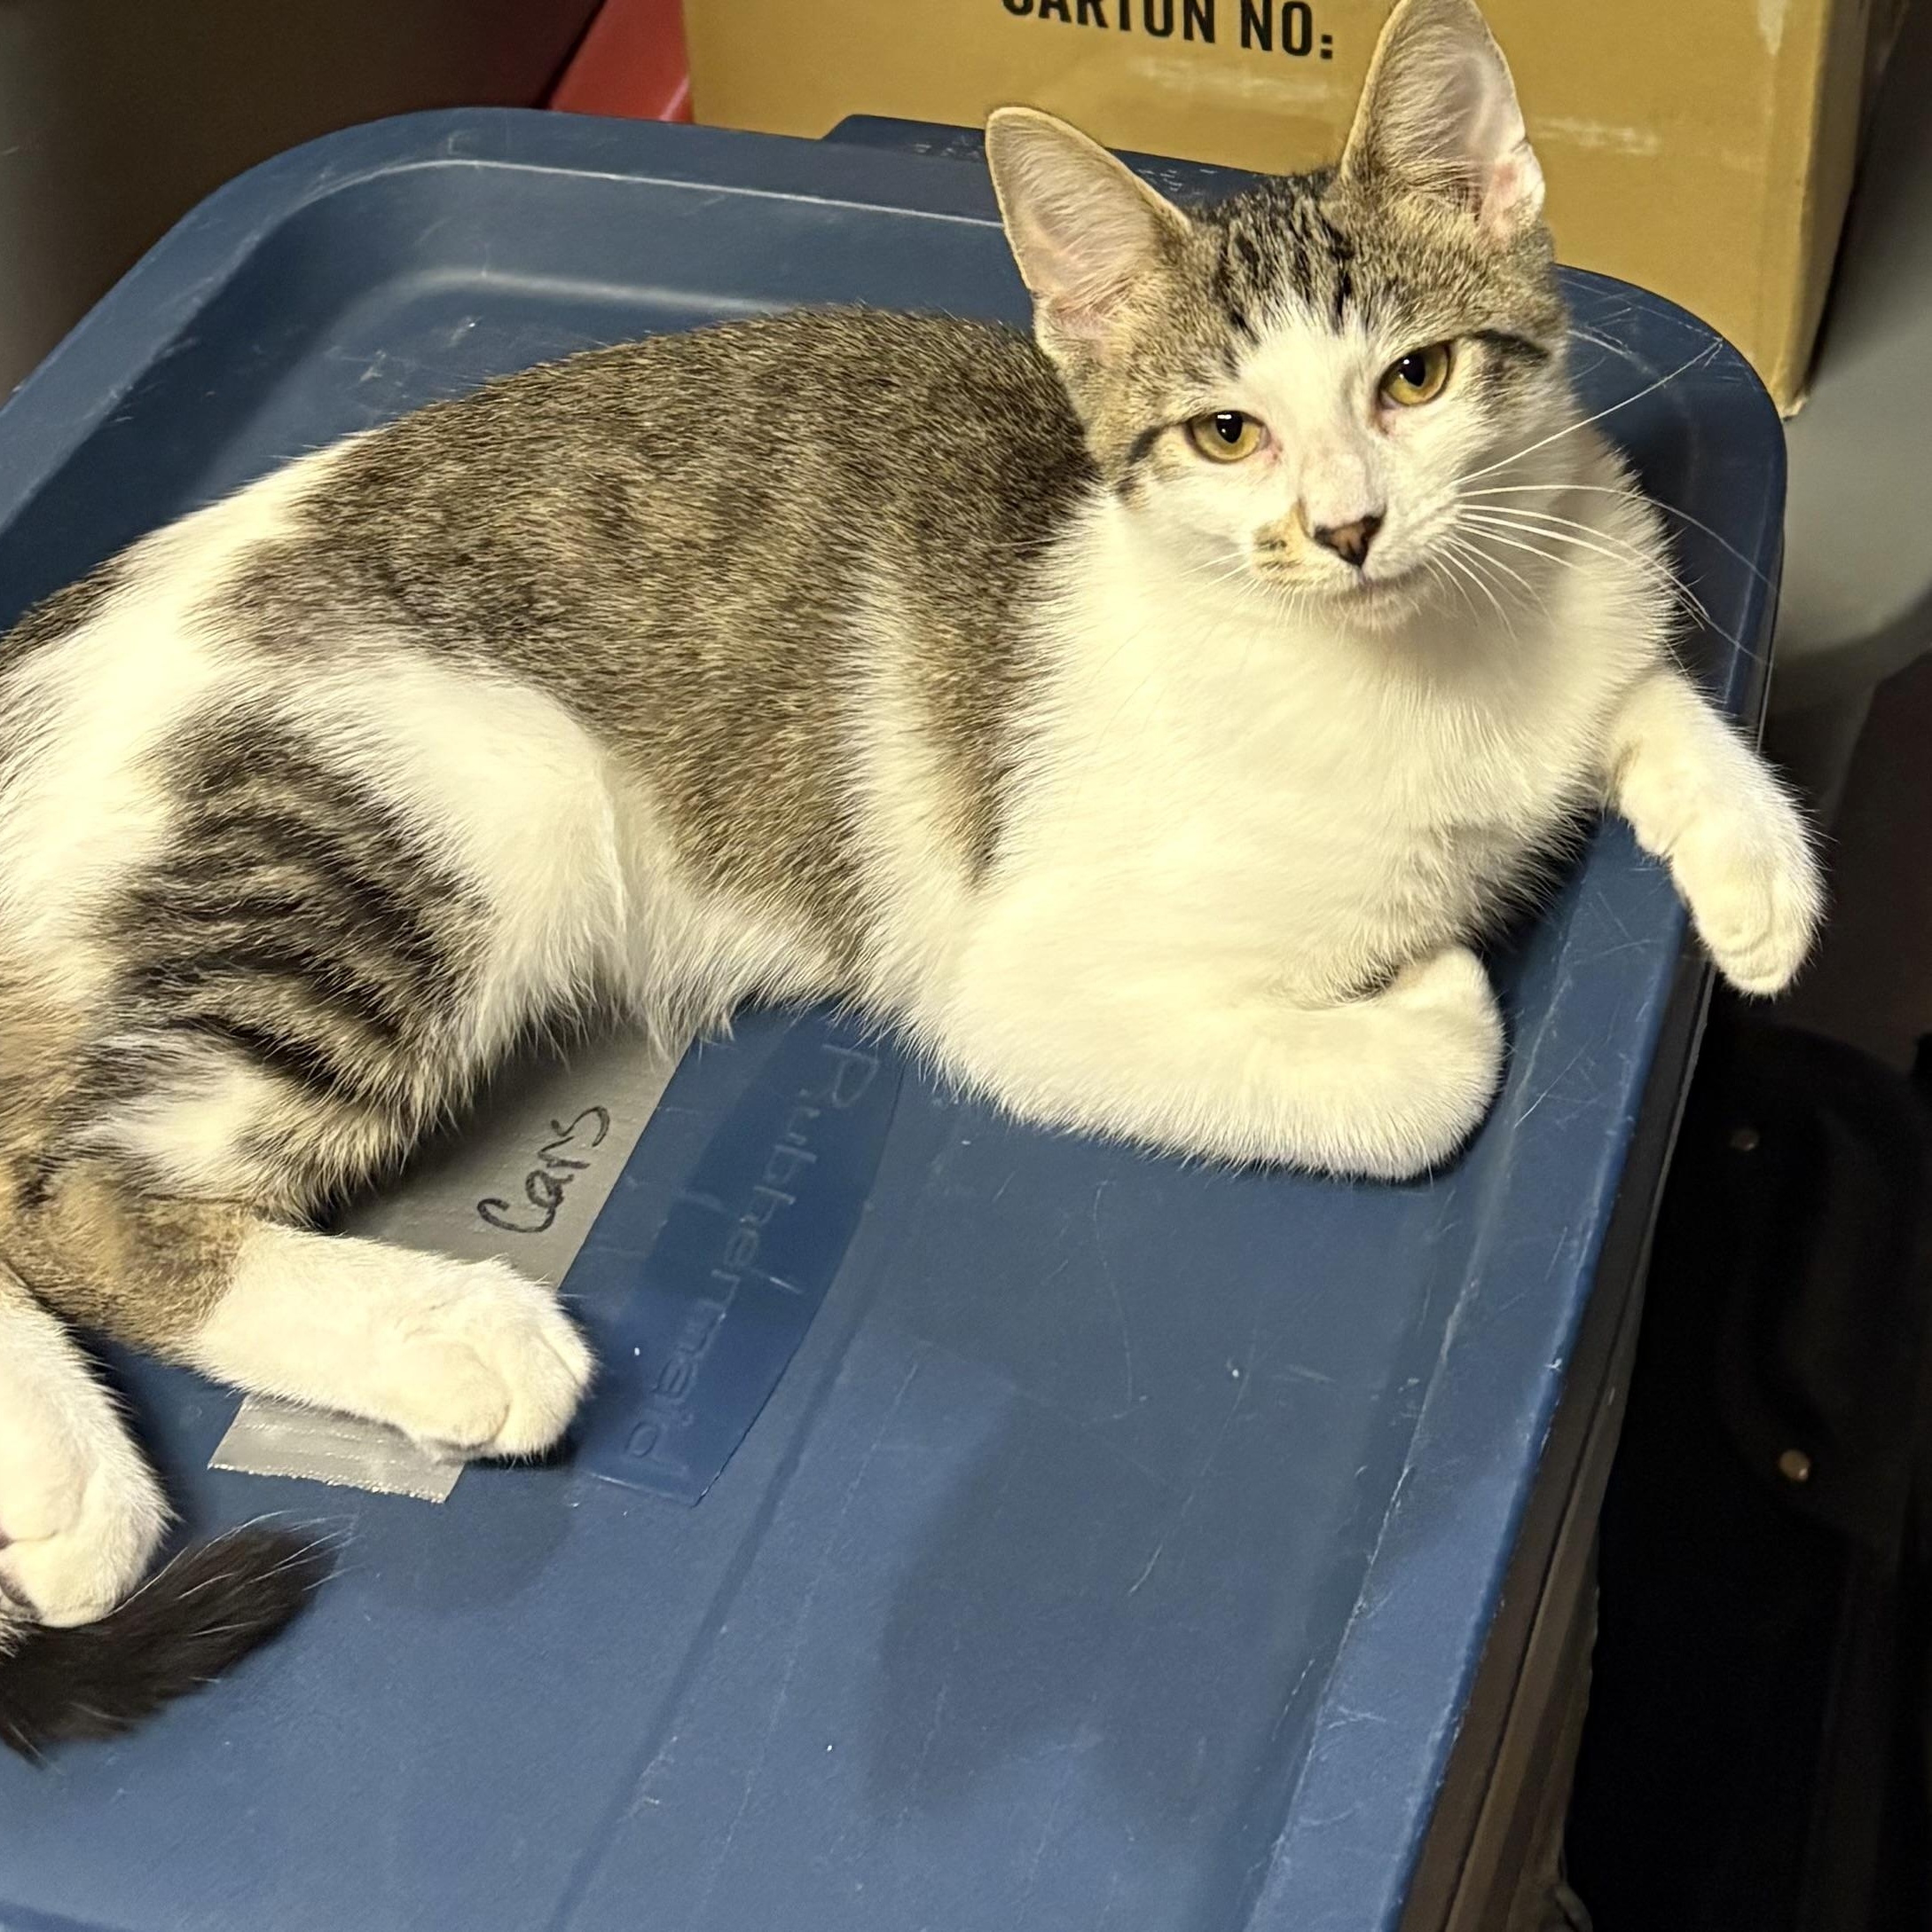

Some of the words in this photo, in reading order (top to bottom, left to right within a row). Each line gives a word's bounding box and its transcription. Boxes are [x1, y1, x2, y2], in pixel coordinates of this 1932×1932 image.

[1002, 0, 1215, 43] RTON
[1240, 0, 1333, 59] NO:
[477, 1107, 609, 1233] Cars
[619, 1043, 879, 1476] Rubbermaid
